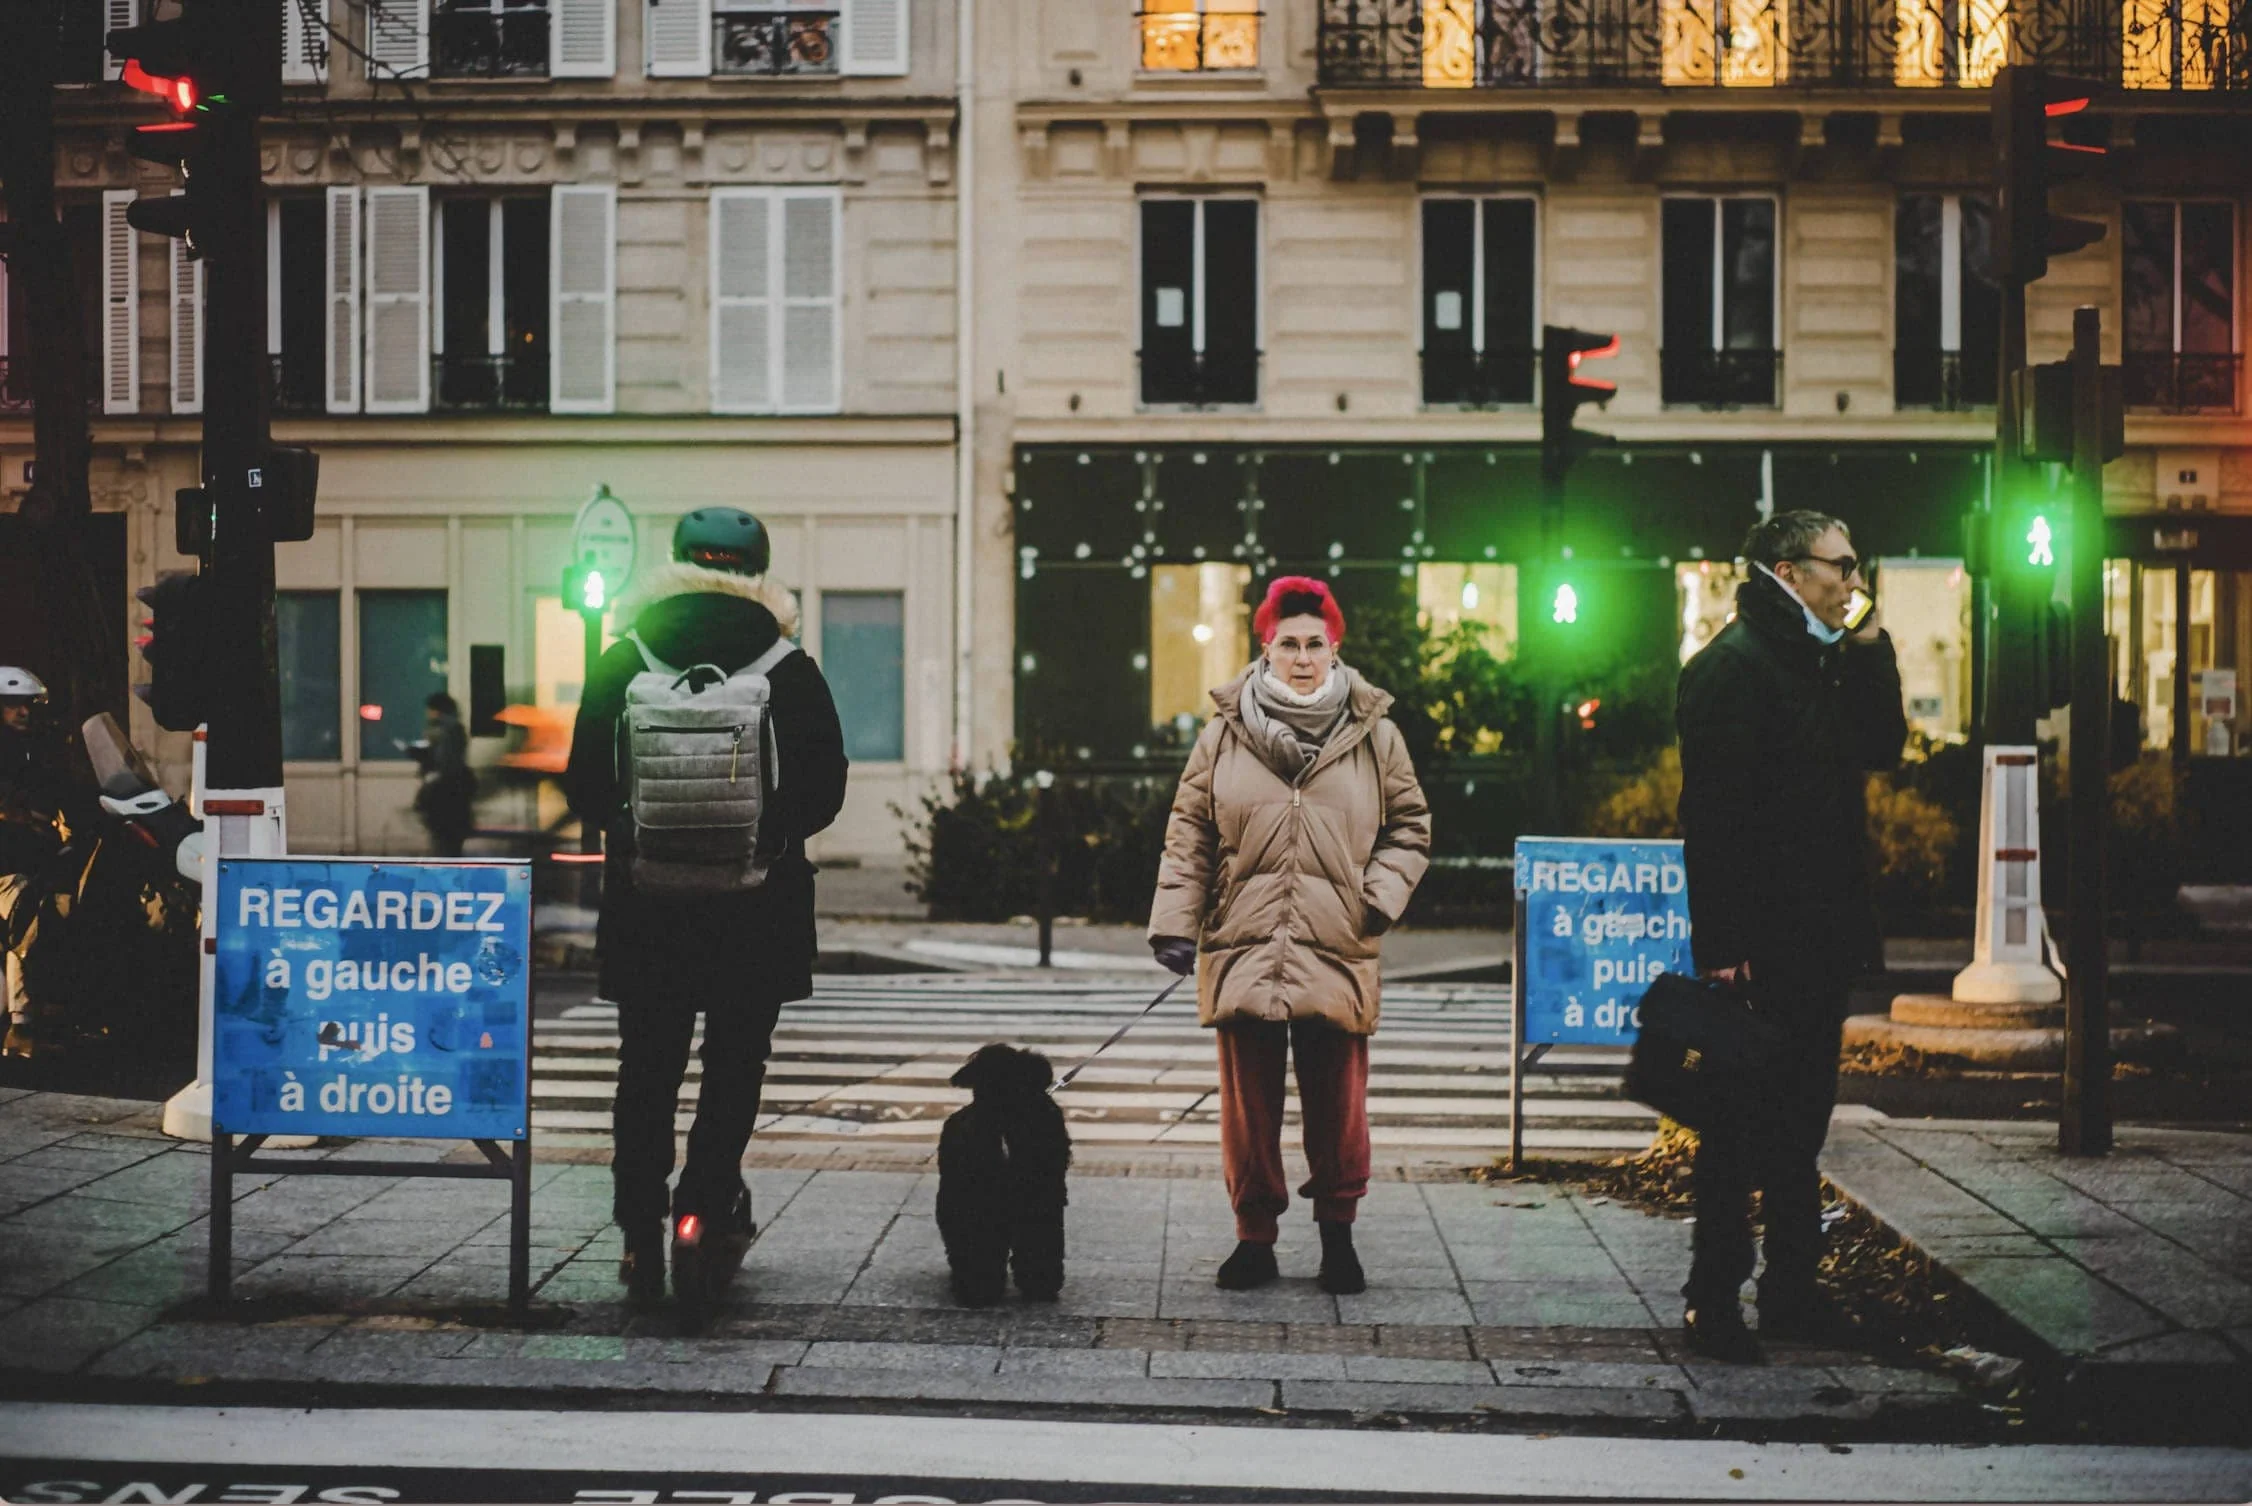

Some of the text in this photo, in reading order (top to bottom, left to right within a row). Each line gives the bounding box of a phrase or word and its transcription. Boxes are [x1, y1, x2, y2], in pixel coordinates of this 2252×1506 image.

[1532, 861, 1685, 894] REGARD
[238, 888, 505, 932] REGARDEZ
[1552, 905, 1693, 945] à gach
[265, 948, 473, 1001] à gauche
[1593, 953, 1666, 990] puis
[1564, 996, 1644, 1029] à dro
[318, 1012, 416, 1062] puis
[279, 1071, 453, 1115] à droite
